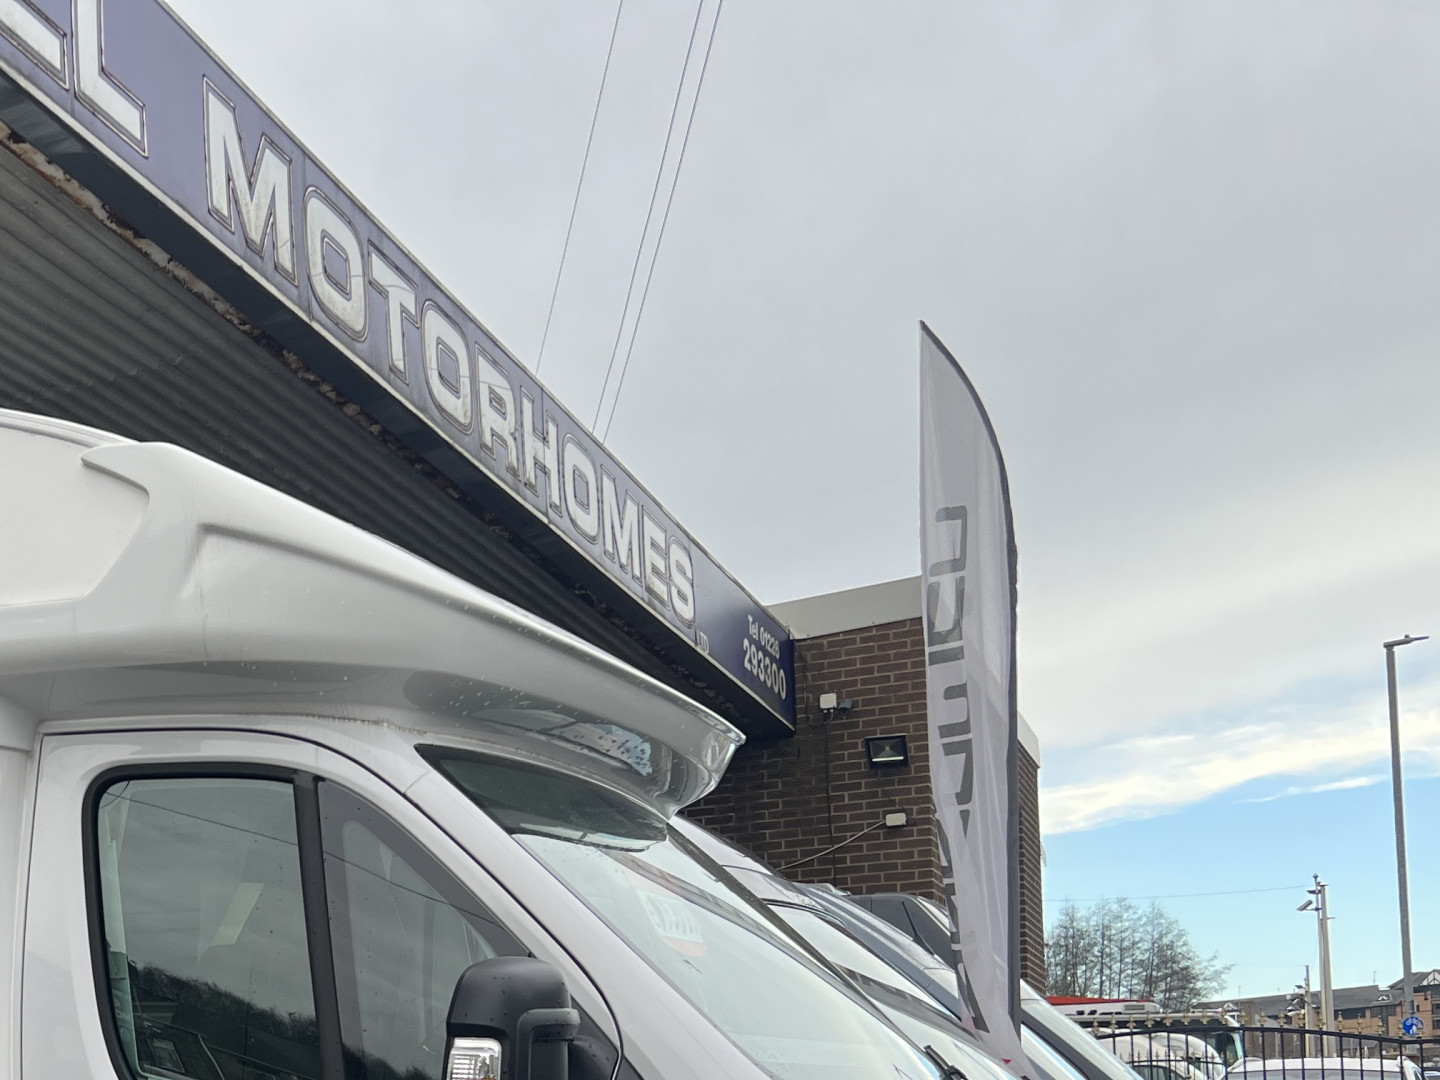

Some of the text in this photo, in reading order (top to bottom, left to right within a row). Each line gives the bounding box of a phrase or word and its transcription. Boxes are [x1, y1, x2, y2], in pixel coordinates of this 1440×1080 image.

[203, 74, 696, 629] MOTORHOMES
[748, 614, 759, 641] Tel
[743, 637, 787, 700] 293300
